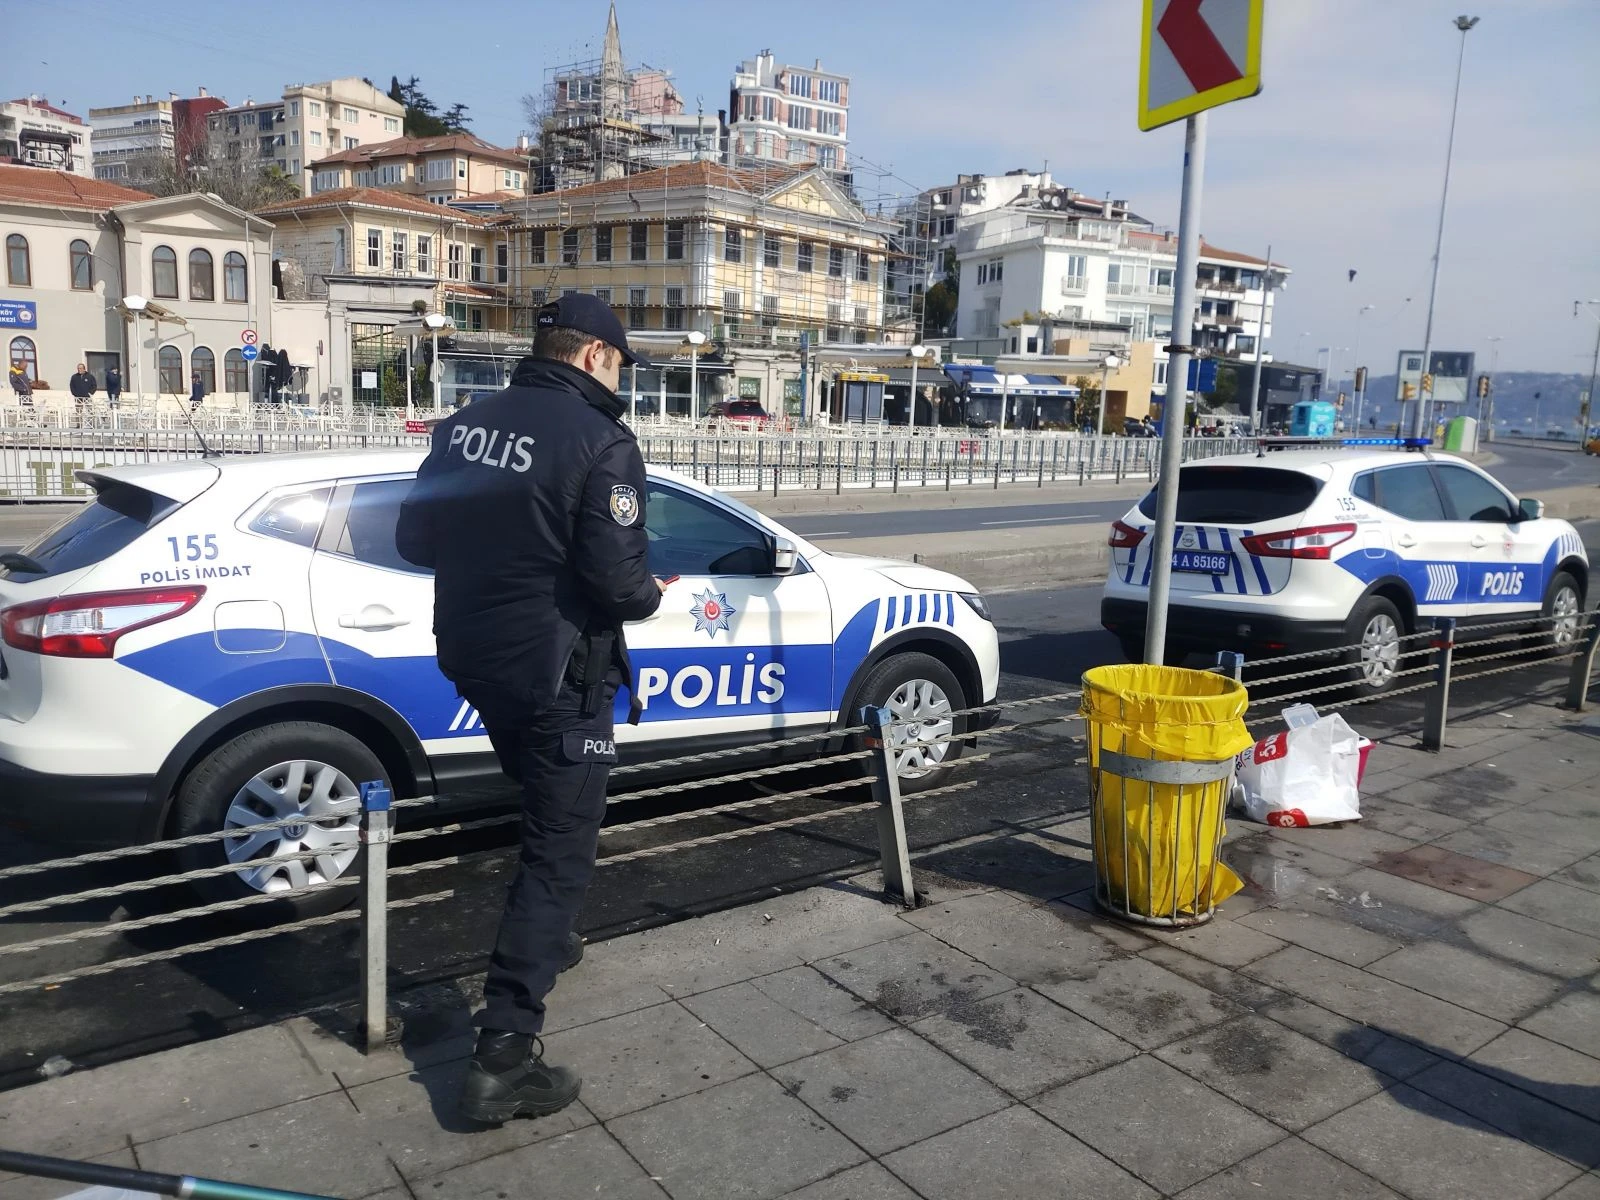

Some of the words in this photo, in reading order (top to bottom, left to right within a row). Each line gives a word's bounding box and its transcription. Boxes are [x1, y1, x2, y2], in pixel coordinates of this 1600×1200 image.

[1337, 497, 1356, 511] 155
[167, 534, 219, 562] 155
[140, 566, 191, 584] POLİS
[195, 564, 251, 579] İMDAT
[1181, 555, 1190, 567] A
[1193, 555, 1226, 570] 85166
[1481, 566, 1525, 596] POLİS
[637, 652, 786, 710] POLİS
